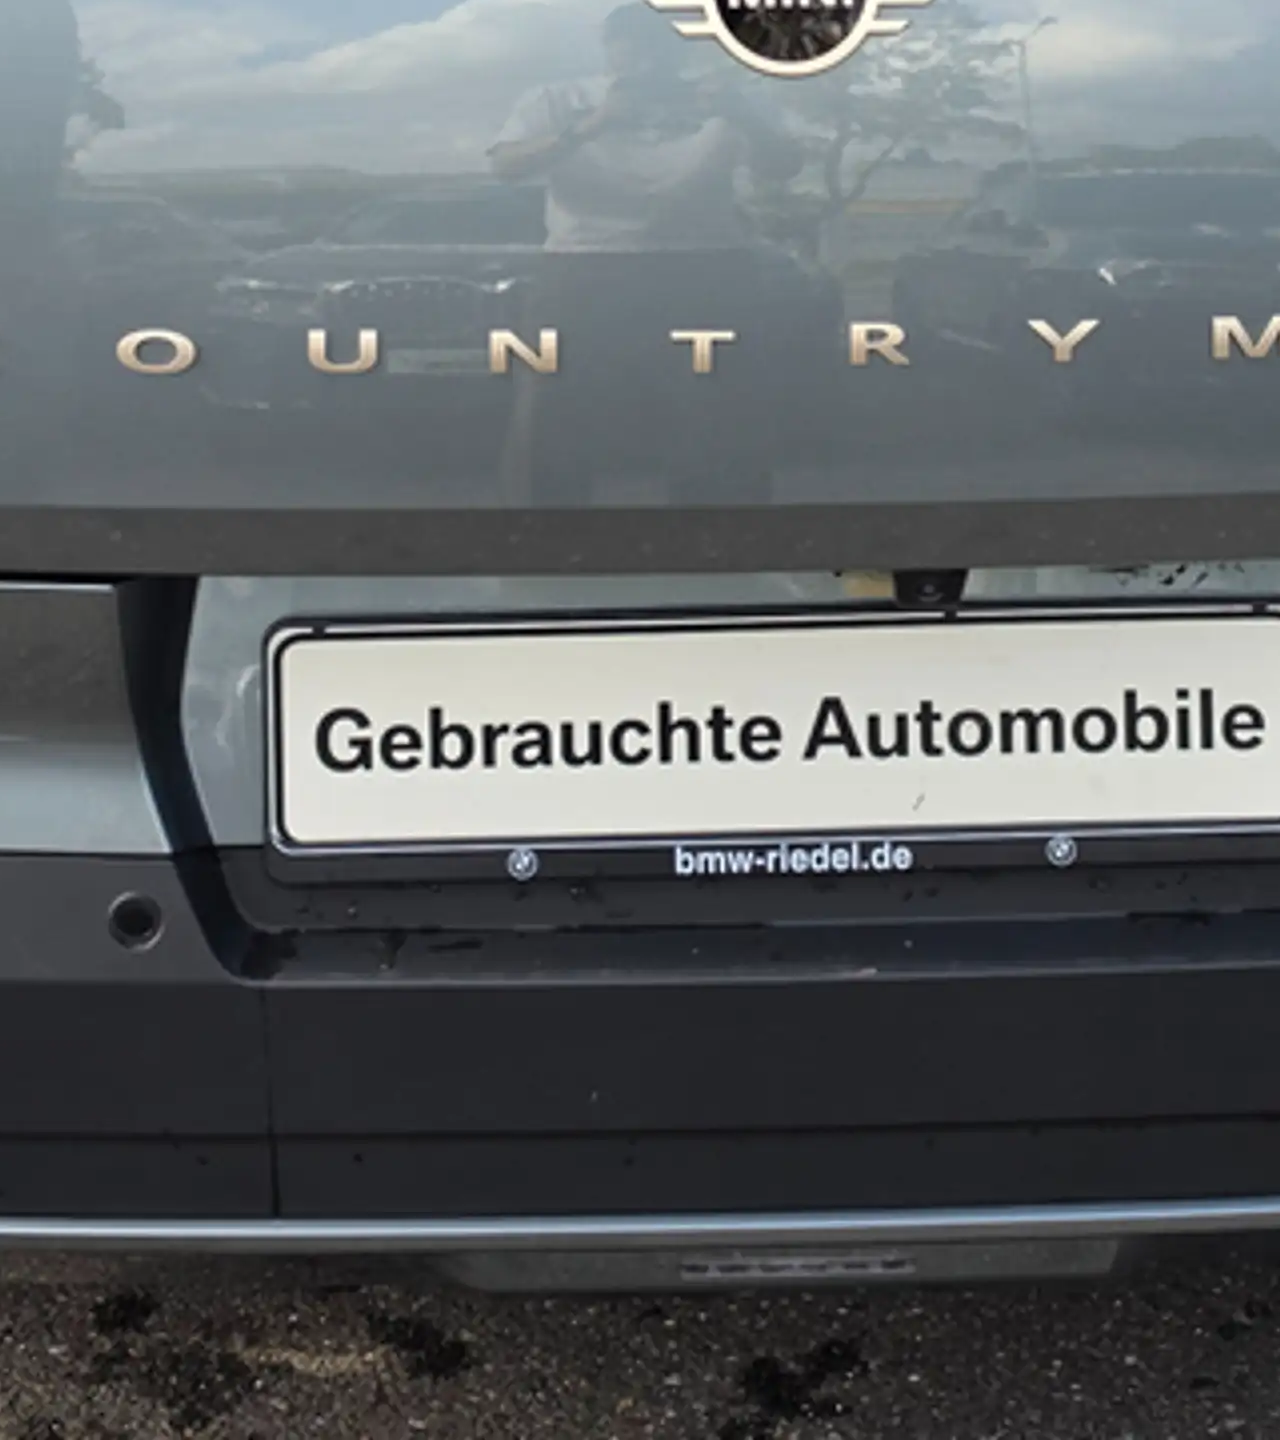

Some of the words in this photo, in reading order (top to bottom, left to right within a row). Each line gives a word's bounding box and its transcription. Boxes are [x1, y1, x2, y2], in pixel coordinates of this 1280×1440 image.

[314, 701, 782, 772] Gebrauchte
[803, 688, 1266, 760] Automobile
[674, 841, 914, 876] bmw-riedel.de
